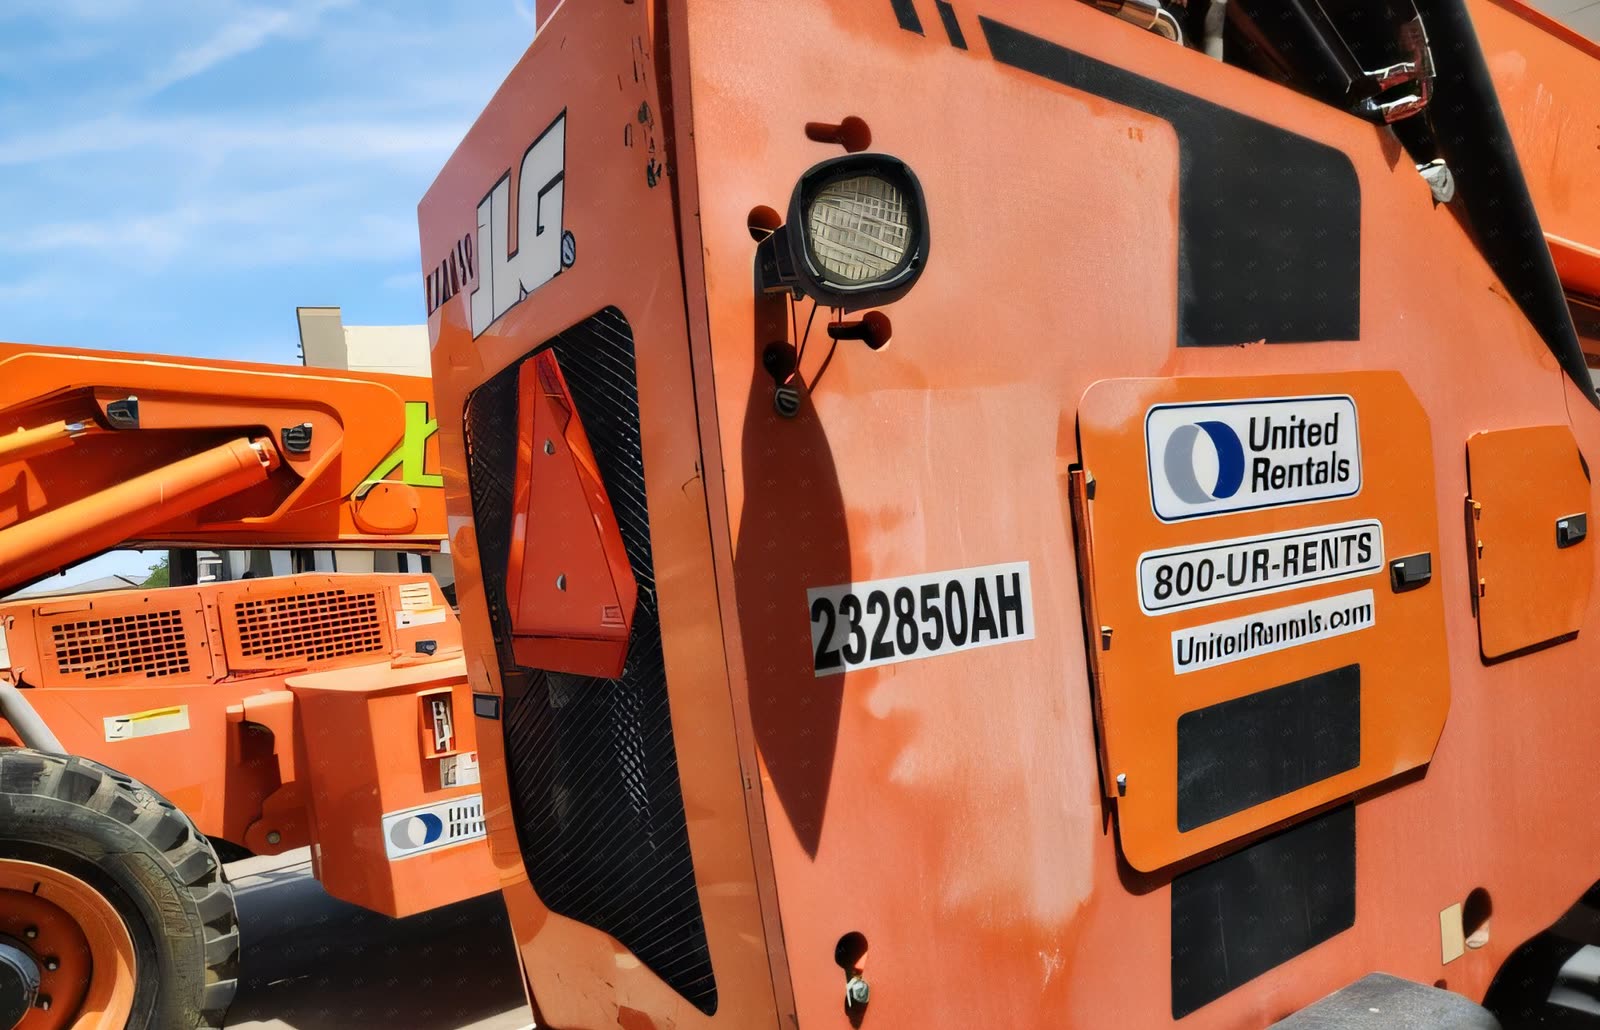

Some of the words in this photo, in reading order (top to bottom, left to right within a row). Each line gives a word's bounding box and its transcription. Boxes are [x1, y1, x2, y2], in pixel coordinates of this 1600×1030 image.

[471, 107, 566, 341] JLG
[1249, 412, 1339, 452] United
[1251, 451, 1350, 493] Rentals
[1154, 532, 1372, 600] 800-UR-RENTS
[811, 572, 1024, 671] 232850AH
